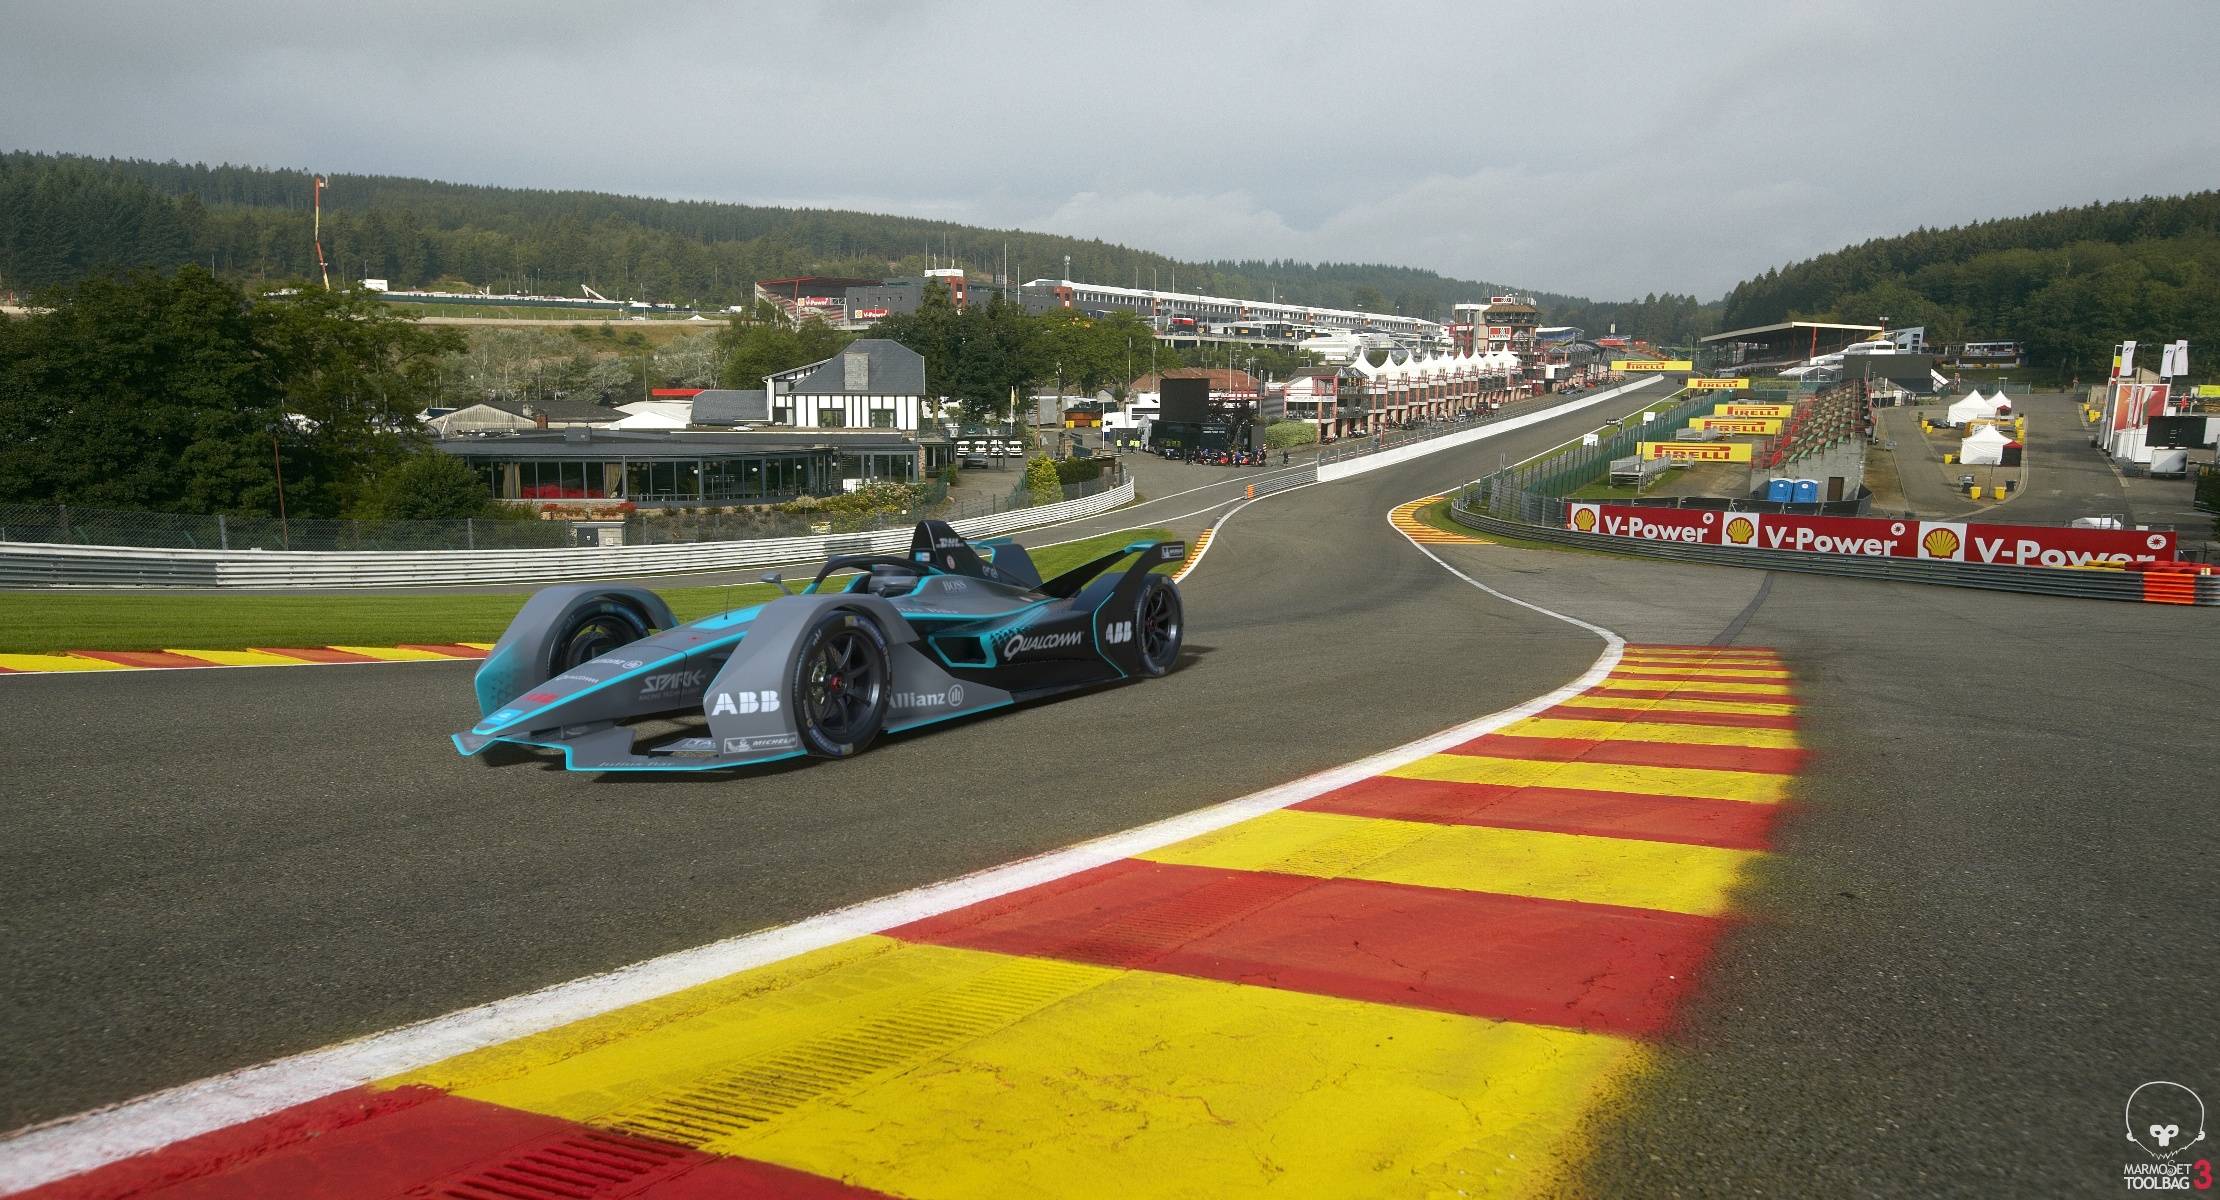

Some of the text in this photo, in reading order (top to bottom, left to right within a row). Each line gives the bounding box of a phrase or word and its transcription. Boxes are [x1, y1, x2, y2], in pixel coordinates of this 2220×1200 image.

[1626, 362, 1665, 370] PIRELLI
[1697, 380, 1739, 388] PIRELLI
[1727, 406, 1779, 416] PIRELLI
[1704, 421, 1766, 432] PRELLI
[1604, 515, 1708, 543] V-Power
[937, 538, 963, 548] DHL
[1765, 525, 1898, 557] V-Power
[943, 580, 967, 591] BOSS
[1105, 621, 1132, 644] ABB
[640, 669, 703, 693] SPARK
[638, 687, 700, 701] RACING TECHNOLOGY
[711, 690, 781, 716] ABB
[752, 736, 796, 747] MICHELIN
